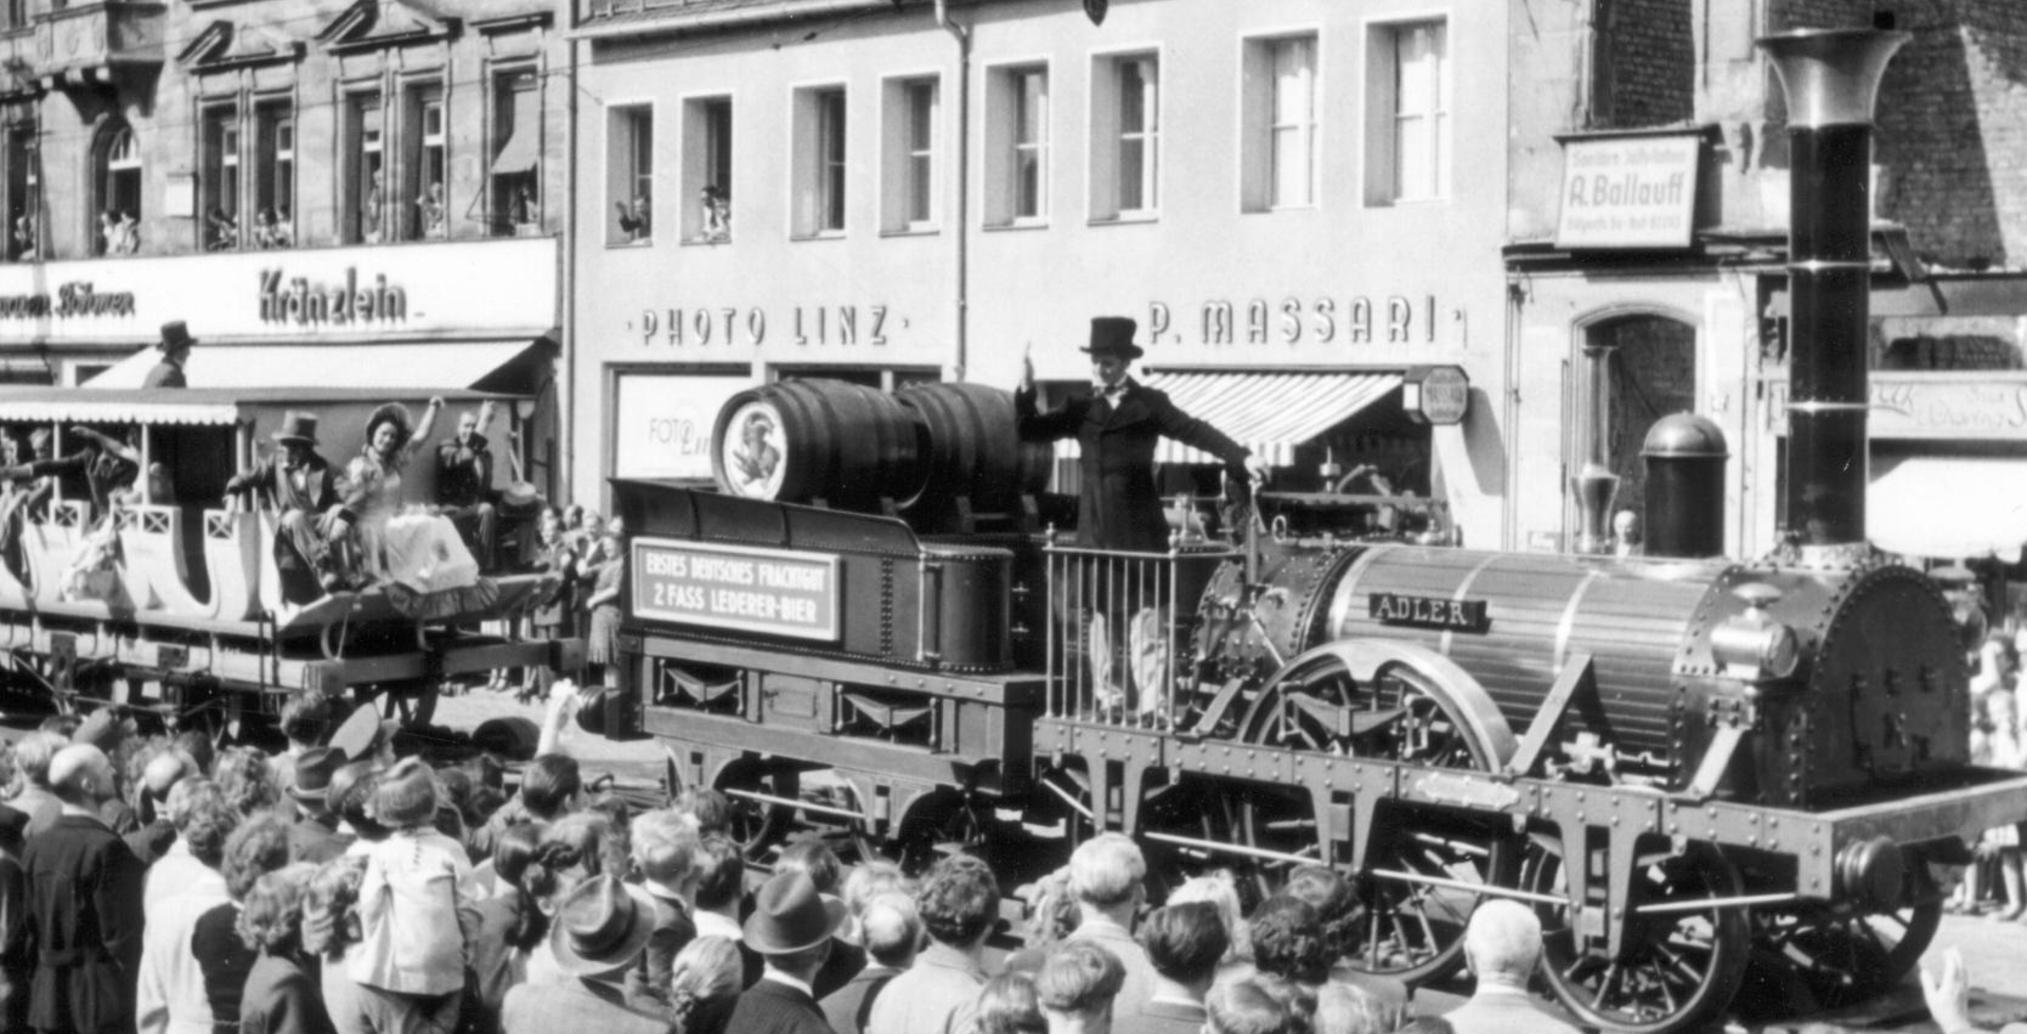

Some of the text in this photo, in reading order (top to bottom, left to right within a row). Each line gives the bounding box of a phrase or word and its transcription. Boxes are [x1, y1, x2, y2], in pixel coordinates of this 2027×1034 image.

[258, 267, 408, 325] Kränzlein
[643, 305, 888, 346] PHOTO LINZ
[1202, 295, 1435, 345] MASSARI
[648, 417, 695, 444] FOTO
[646, 552, 688, 577] ERSTES
[691, 556, 755, 585] DEUTSCHES
[654, 583, 818, 623] 2 FASS LEDERER-BIER
[1376, 596, 1468, 626] ADLER
